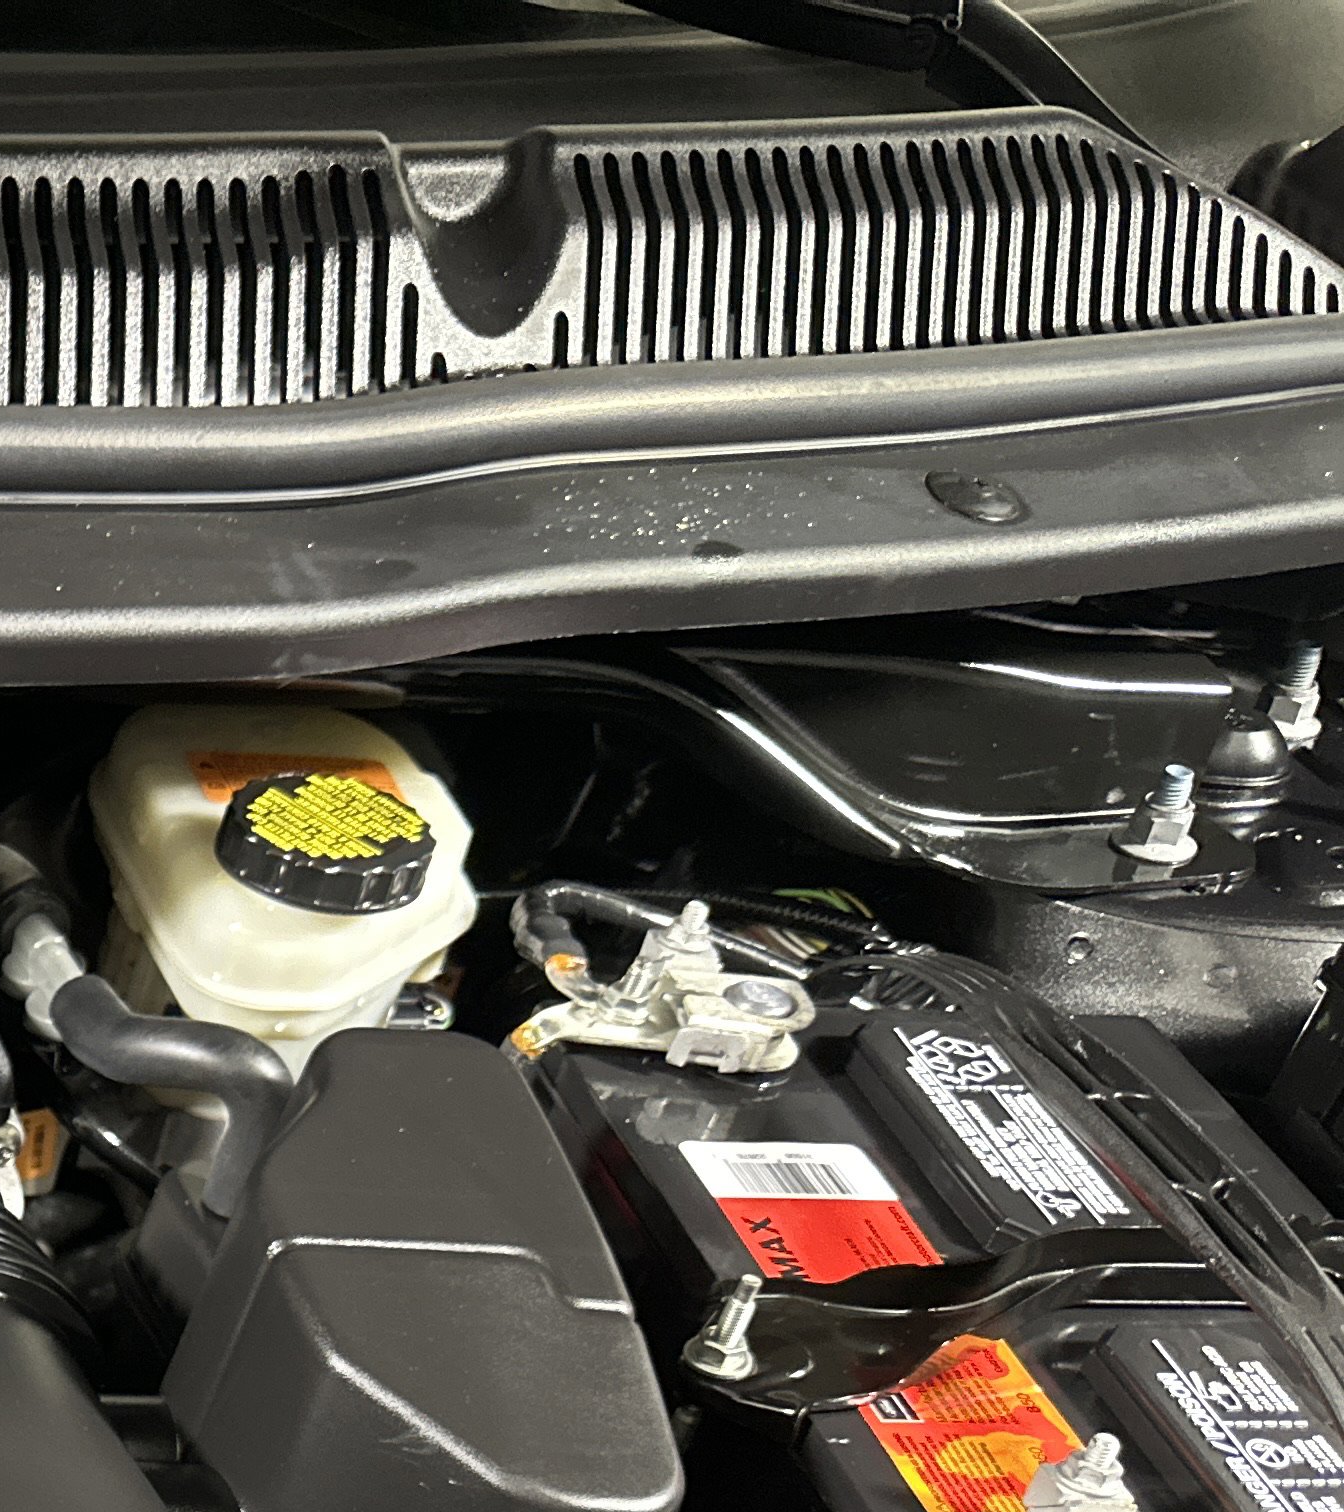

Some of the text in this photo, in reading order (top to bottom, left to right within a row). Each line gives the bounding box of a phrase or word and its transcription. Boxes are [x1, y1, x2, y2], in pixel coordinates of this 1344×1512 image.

[740, 1216, 810, 1281] MAX
[887, 1206, 933, 1265] otorcraft.com
[1155, 1372, 1226, 1441] POISON
